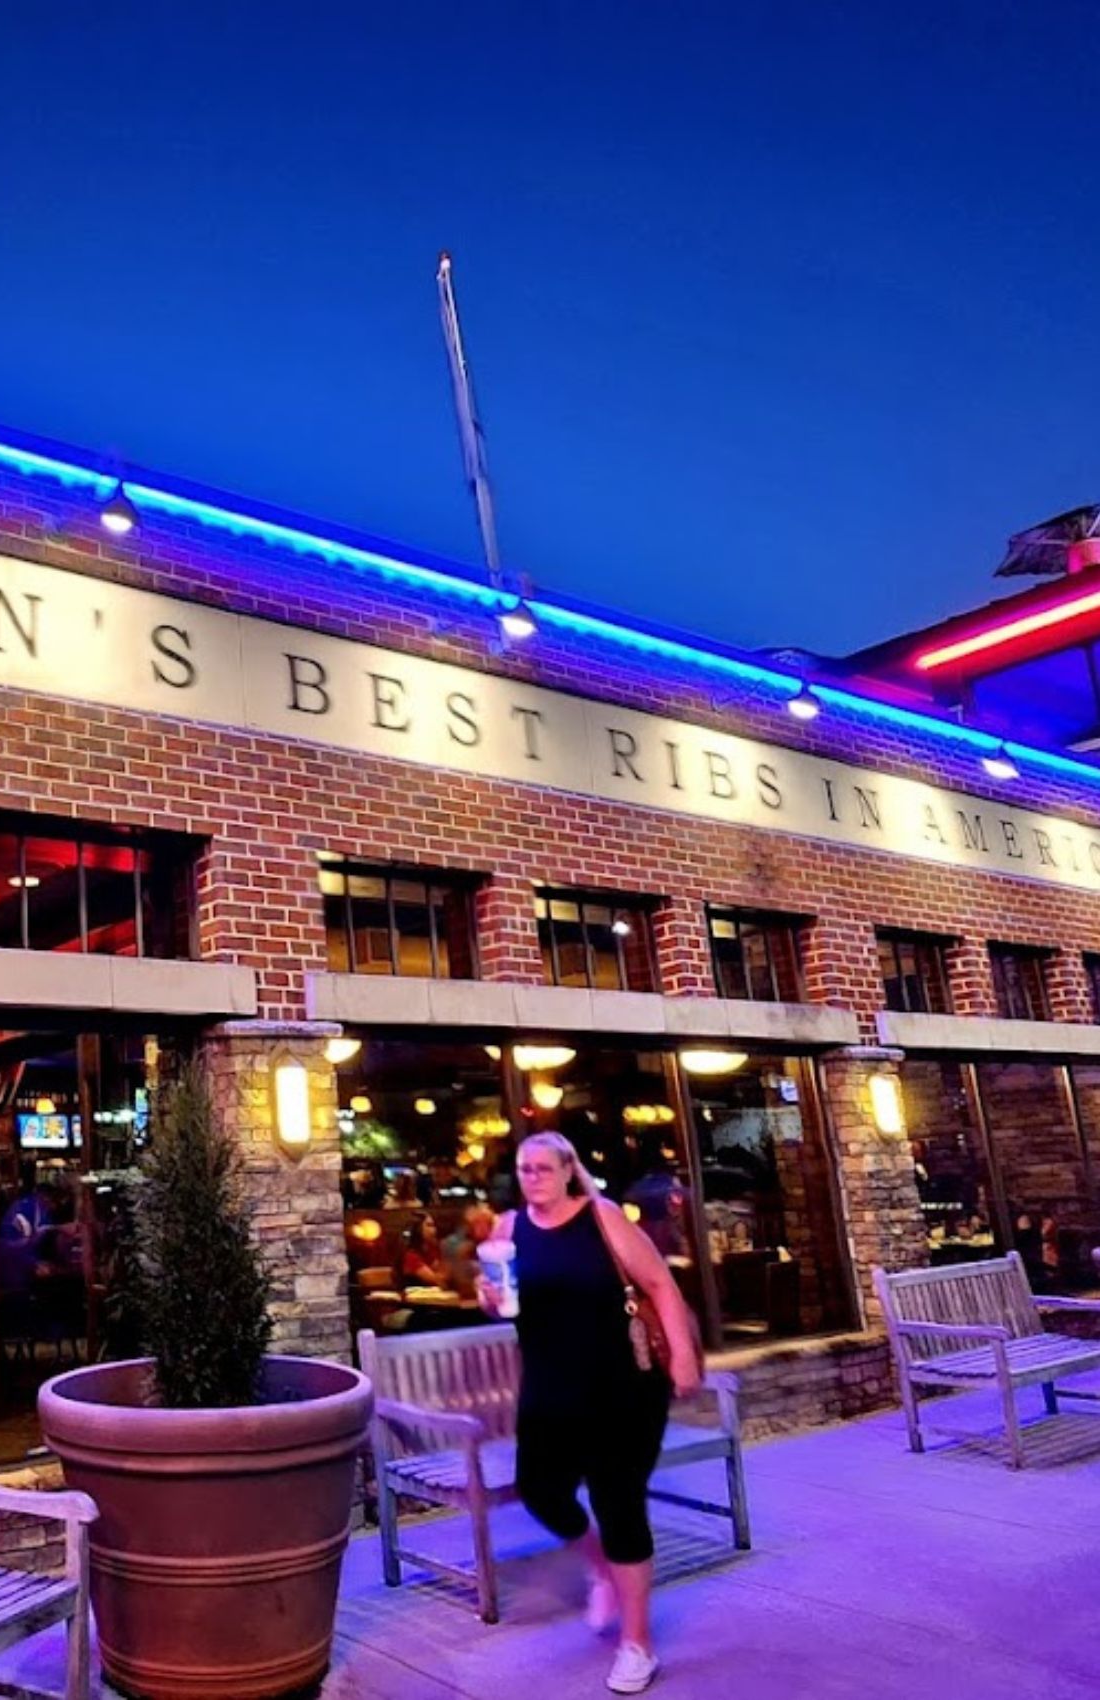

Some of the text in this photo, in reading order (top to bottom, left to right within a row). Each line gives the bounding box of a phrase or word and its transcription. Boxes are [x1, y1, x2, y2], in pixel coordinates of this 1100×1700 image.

[282, 652, 542, 761] BEST
[605, 727, 782, 810] RIBS
[822, 777, 882, 830] IN
